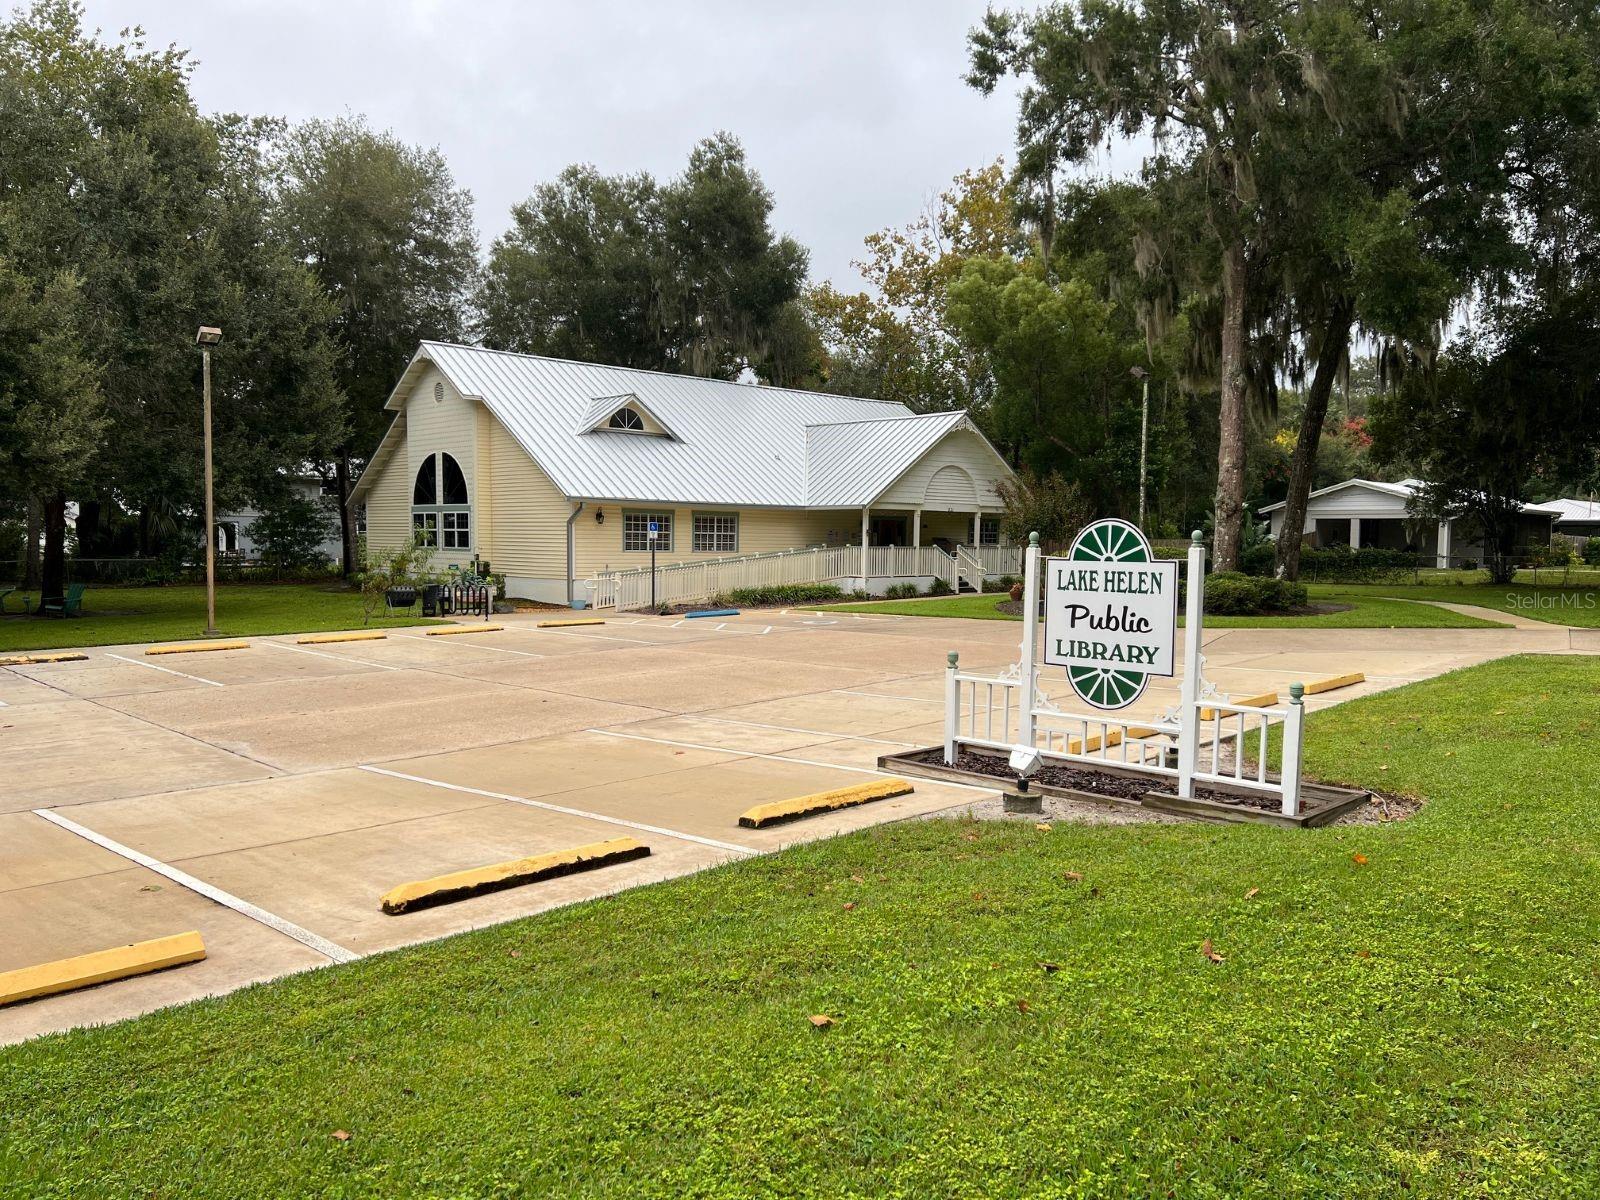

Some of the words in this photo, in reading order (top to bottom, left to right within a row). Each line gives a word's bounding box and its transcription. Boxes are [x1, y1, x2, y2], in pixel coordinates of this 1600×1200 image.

[1057, 569, 1100, 592] LAKE
[1103, 570, 1163, 595] HELEN
[1064, 603, 1153, 634] Public
[1055, 638, 1160, 665] LIBRARY
